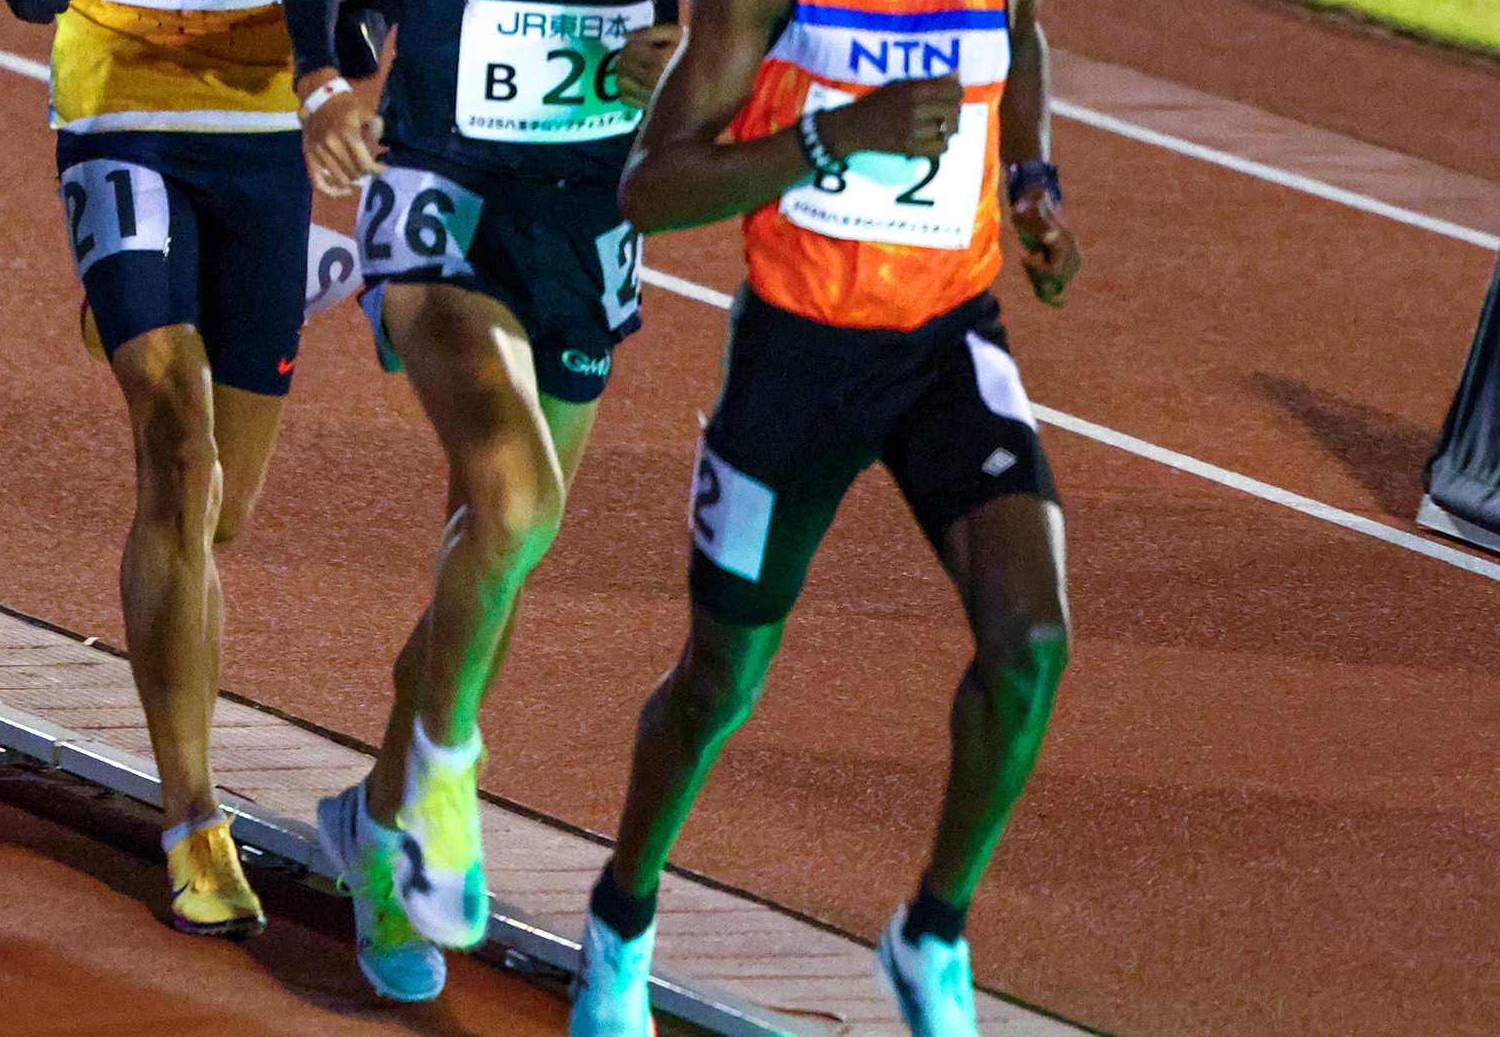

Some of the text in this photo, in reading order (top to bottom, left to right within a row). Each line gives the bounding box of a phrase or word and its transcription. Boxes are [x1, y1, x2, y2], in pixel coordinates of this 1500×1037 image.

[484, 63, 518, 101] B
[849, 38, 960, 78] NTN
[895, 154, 935, 206] 2
[64, 169, 137, 263] 21
[365, 179, 455, 261] 26
